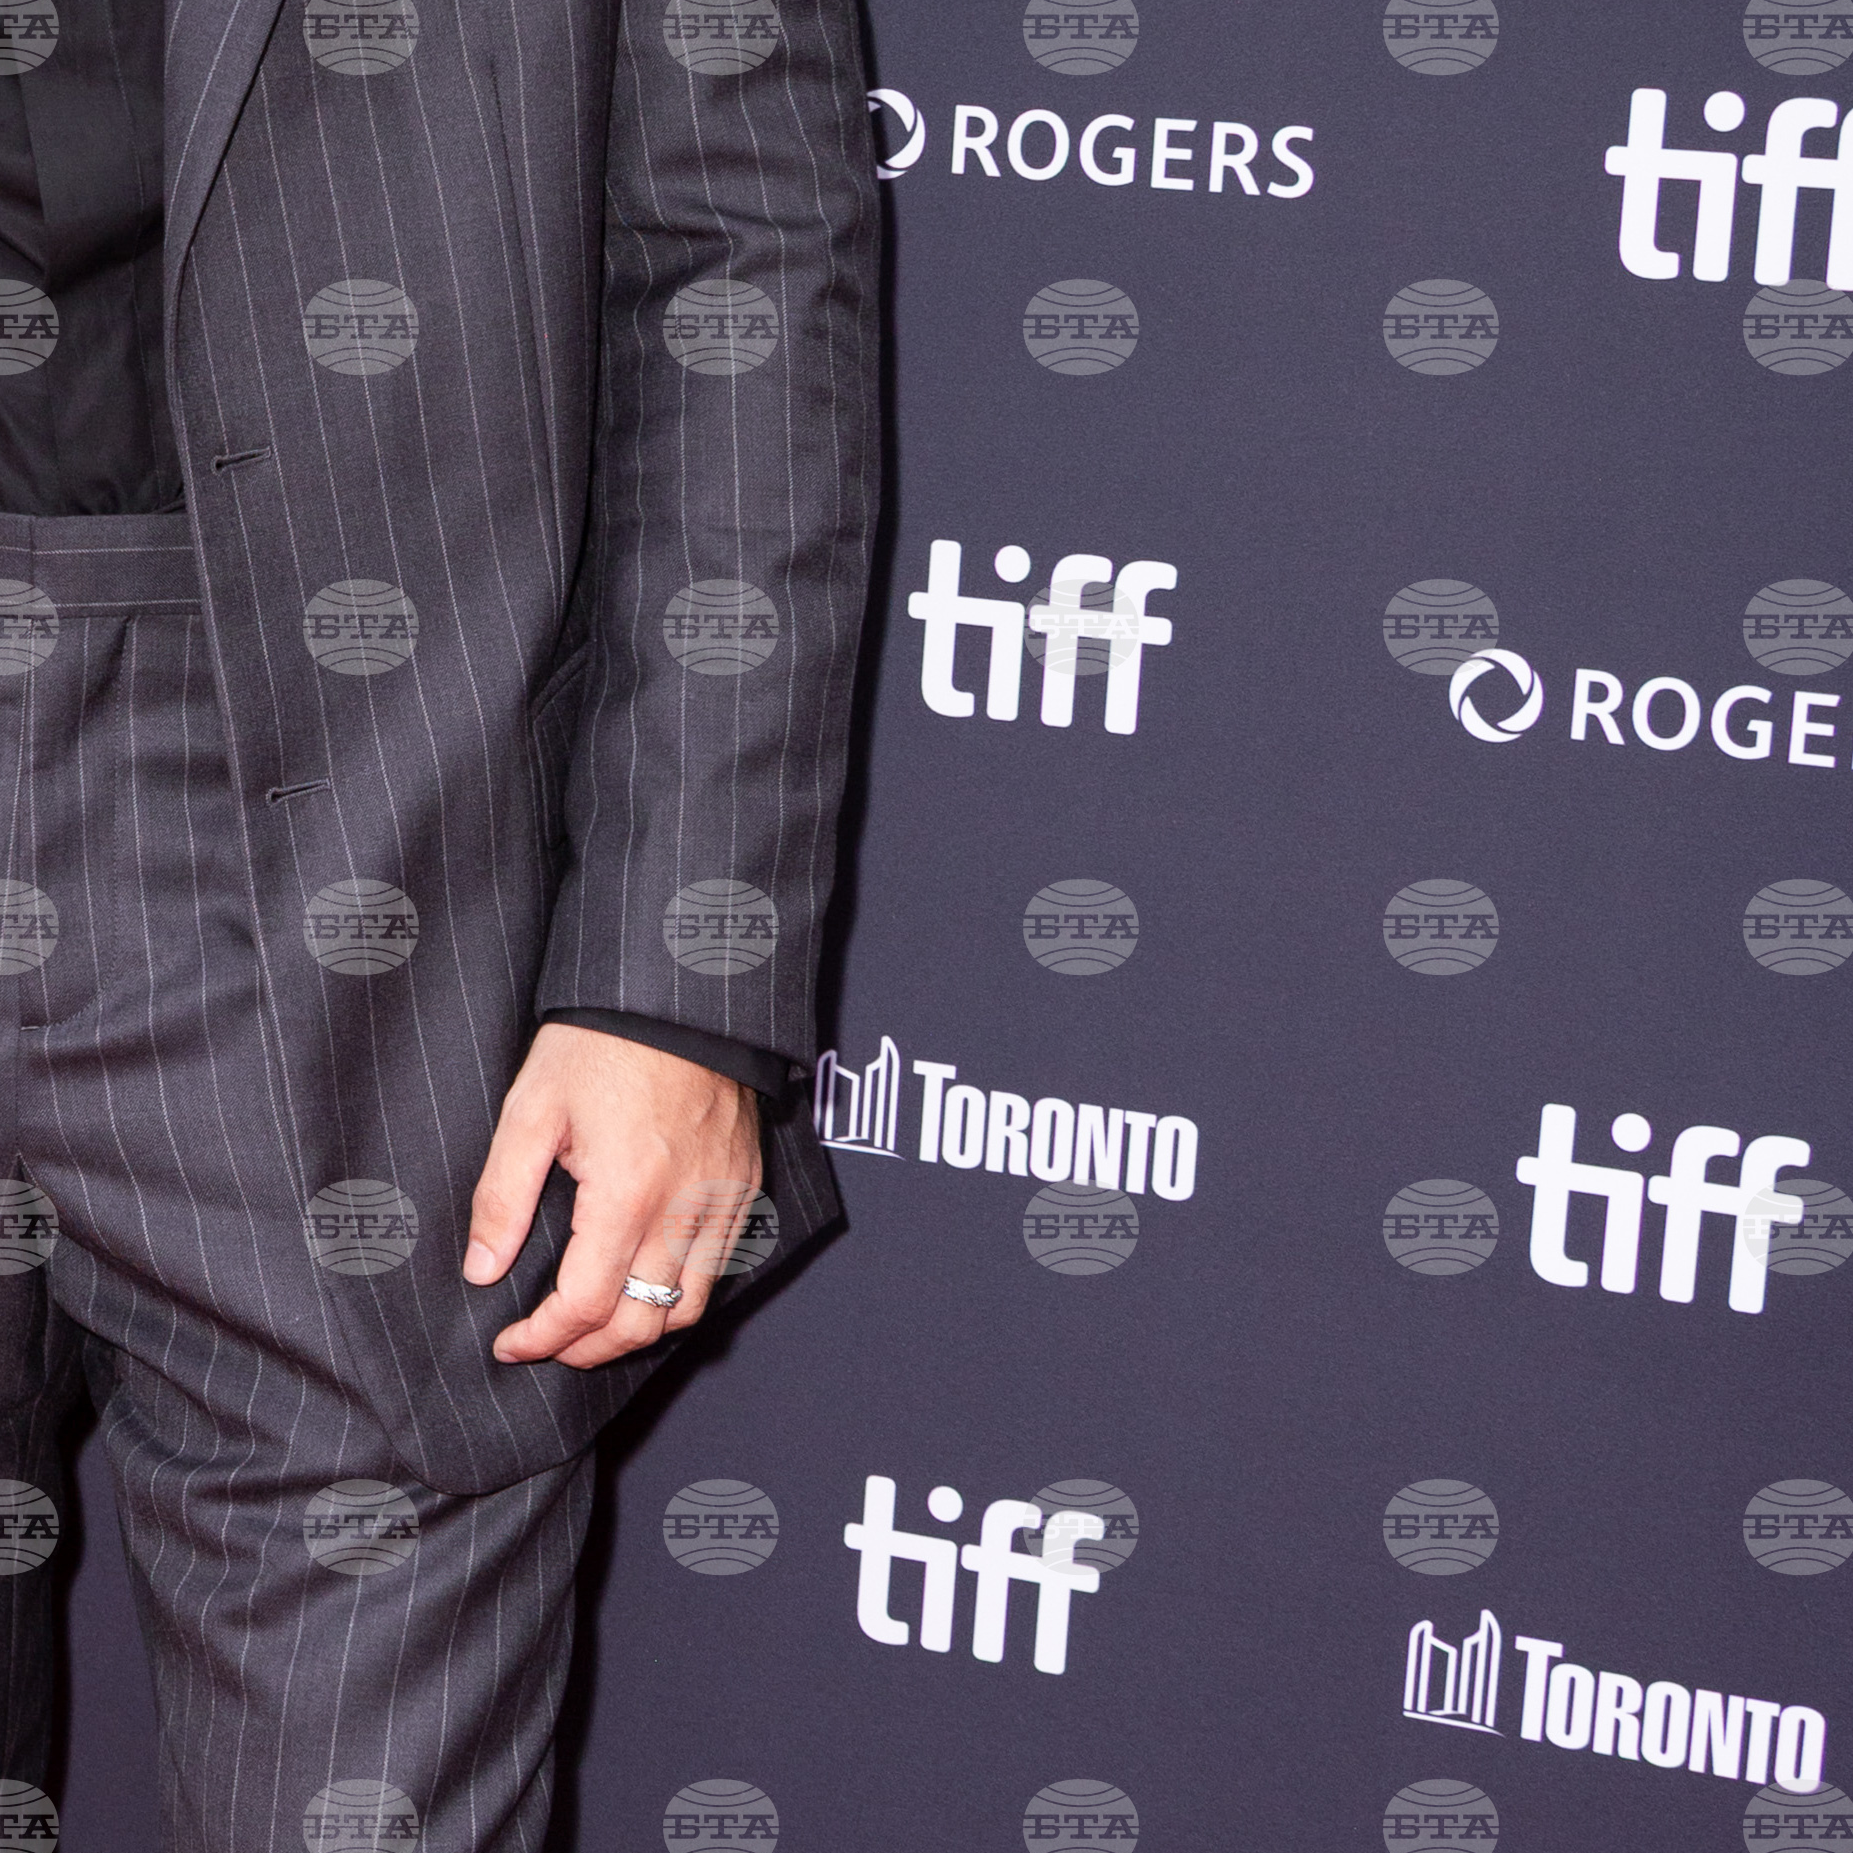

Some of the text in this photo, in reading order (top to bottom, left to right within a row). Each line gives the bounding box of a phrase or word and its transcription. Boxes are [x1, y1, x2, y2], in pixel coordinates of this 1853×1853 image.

[952, 105, 1313, 198] ROGERS
[908, 540, 1177, 734] tiff
[1571, 669, 1840, 767] ROGE
[913, 1060, 1198, 1200] TORONTO
[1516, 1104, 1810, 1313] tiff
[844, 1476, 1105, 1674] tiff
[1516, 1636, 1825, 1793] TORONTO
